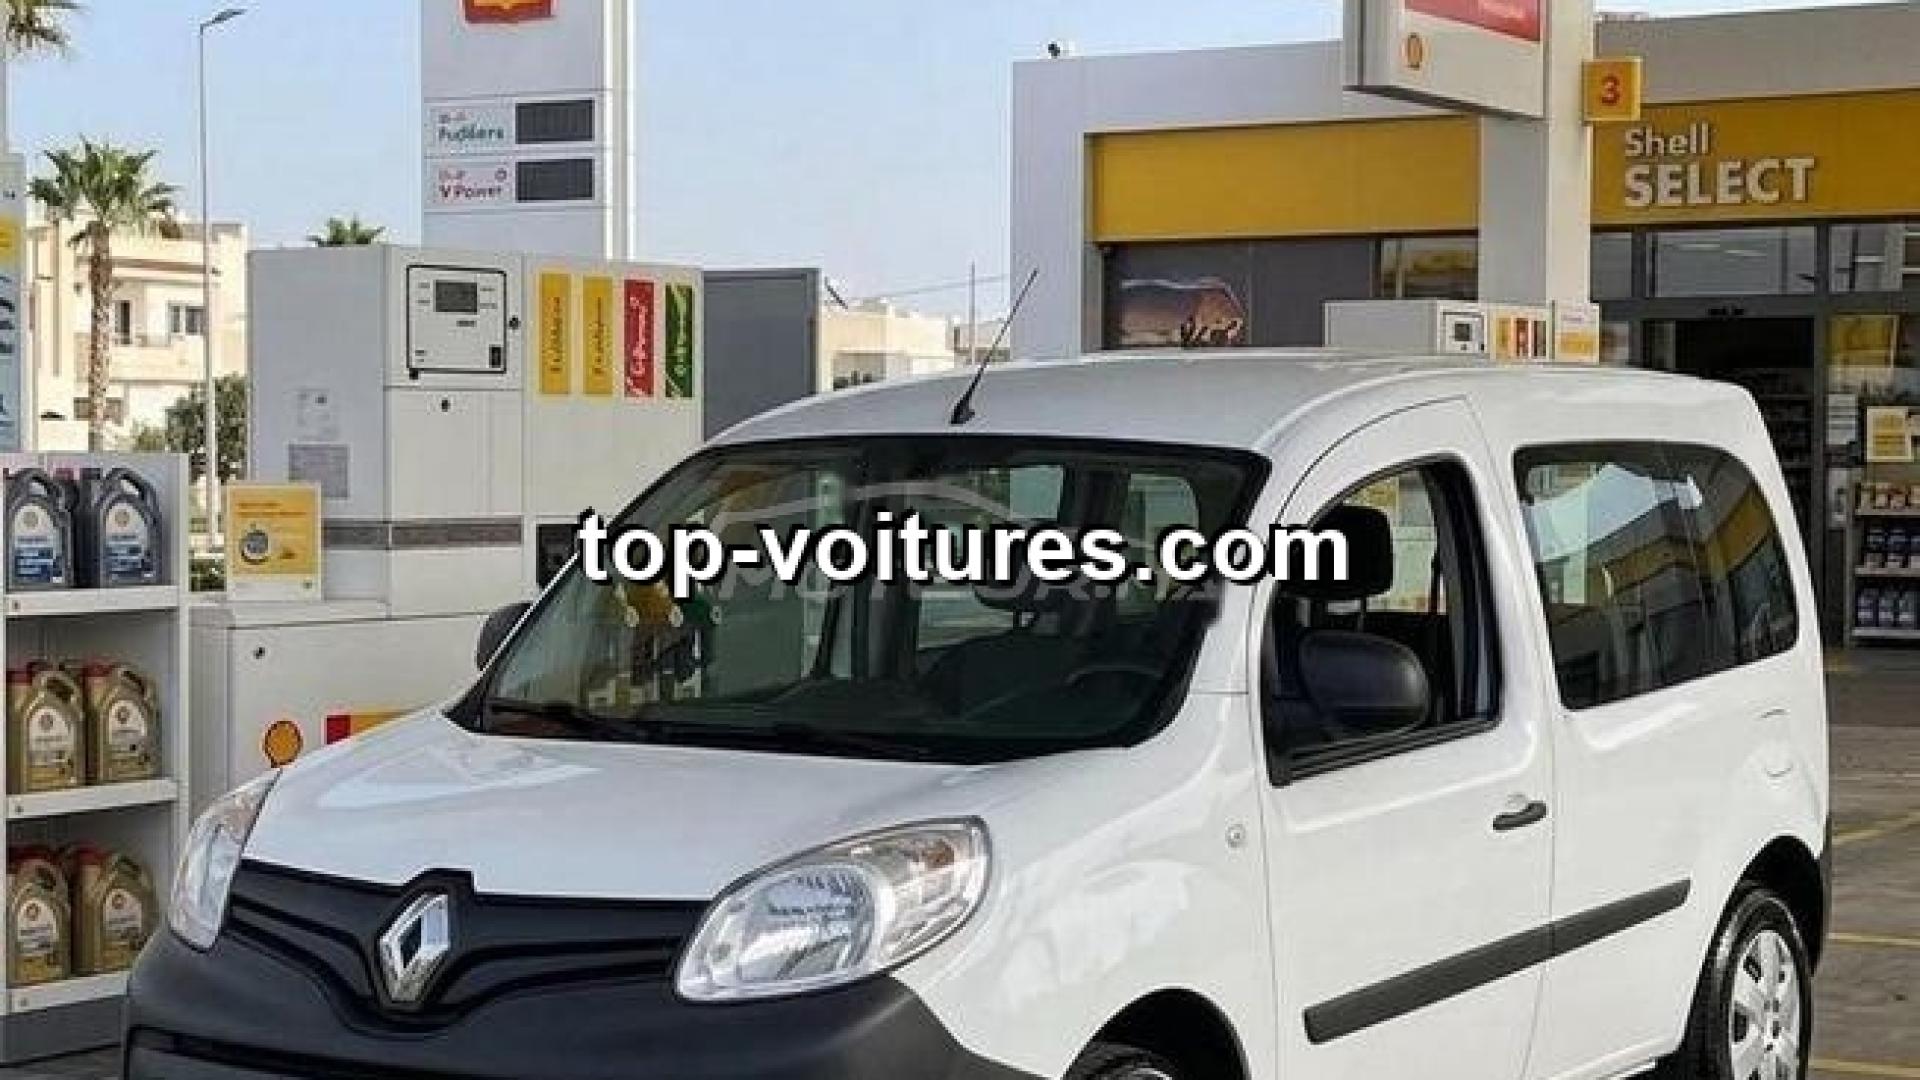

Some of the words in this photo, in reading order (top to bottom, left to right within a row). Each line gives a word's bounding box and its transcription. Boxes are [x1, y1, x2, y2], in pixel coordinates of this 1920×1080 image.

[1601, 74, 1621, 106] 3
[1624, 122, 1709, 157] Shell
[1624, 158, 1815, 207] SELECT
